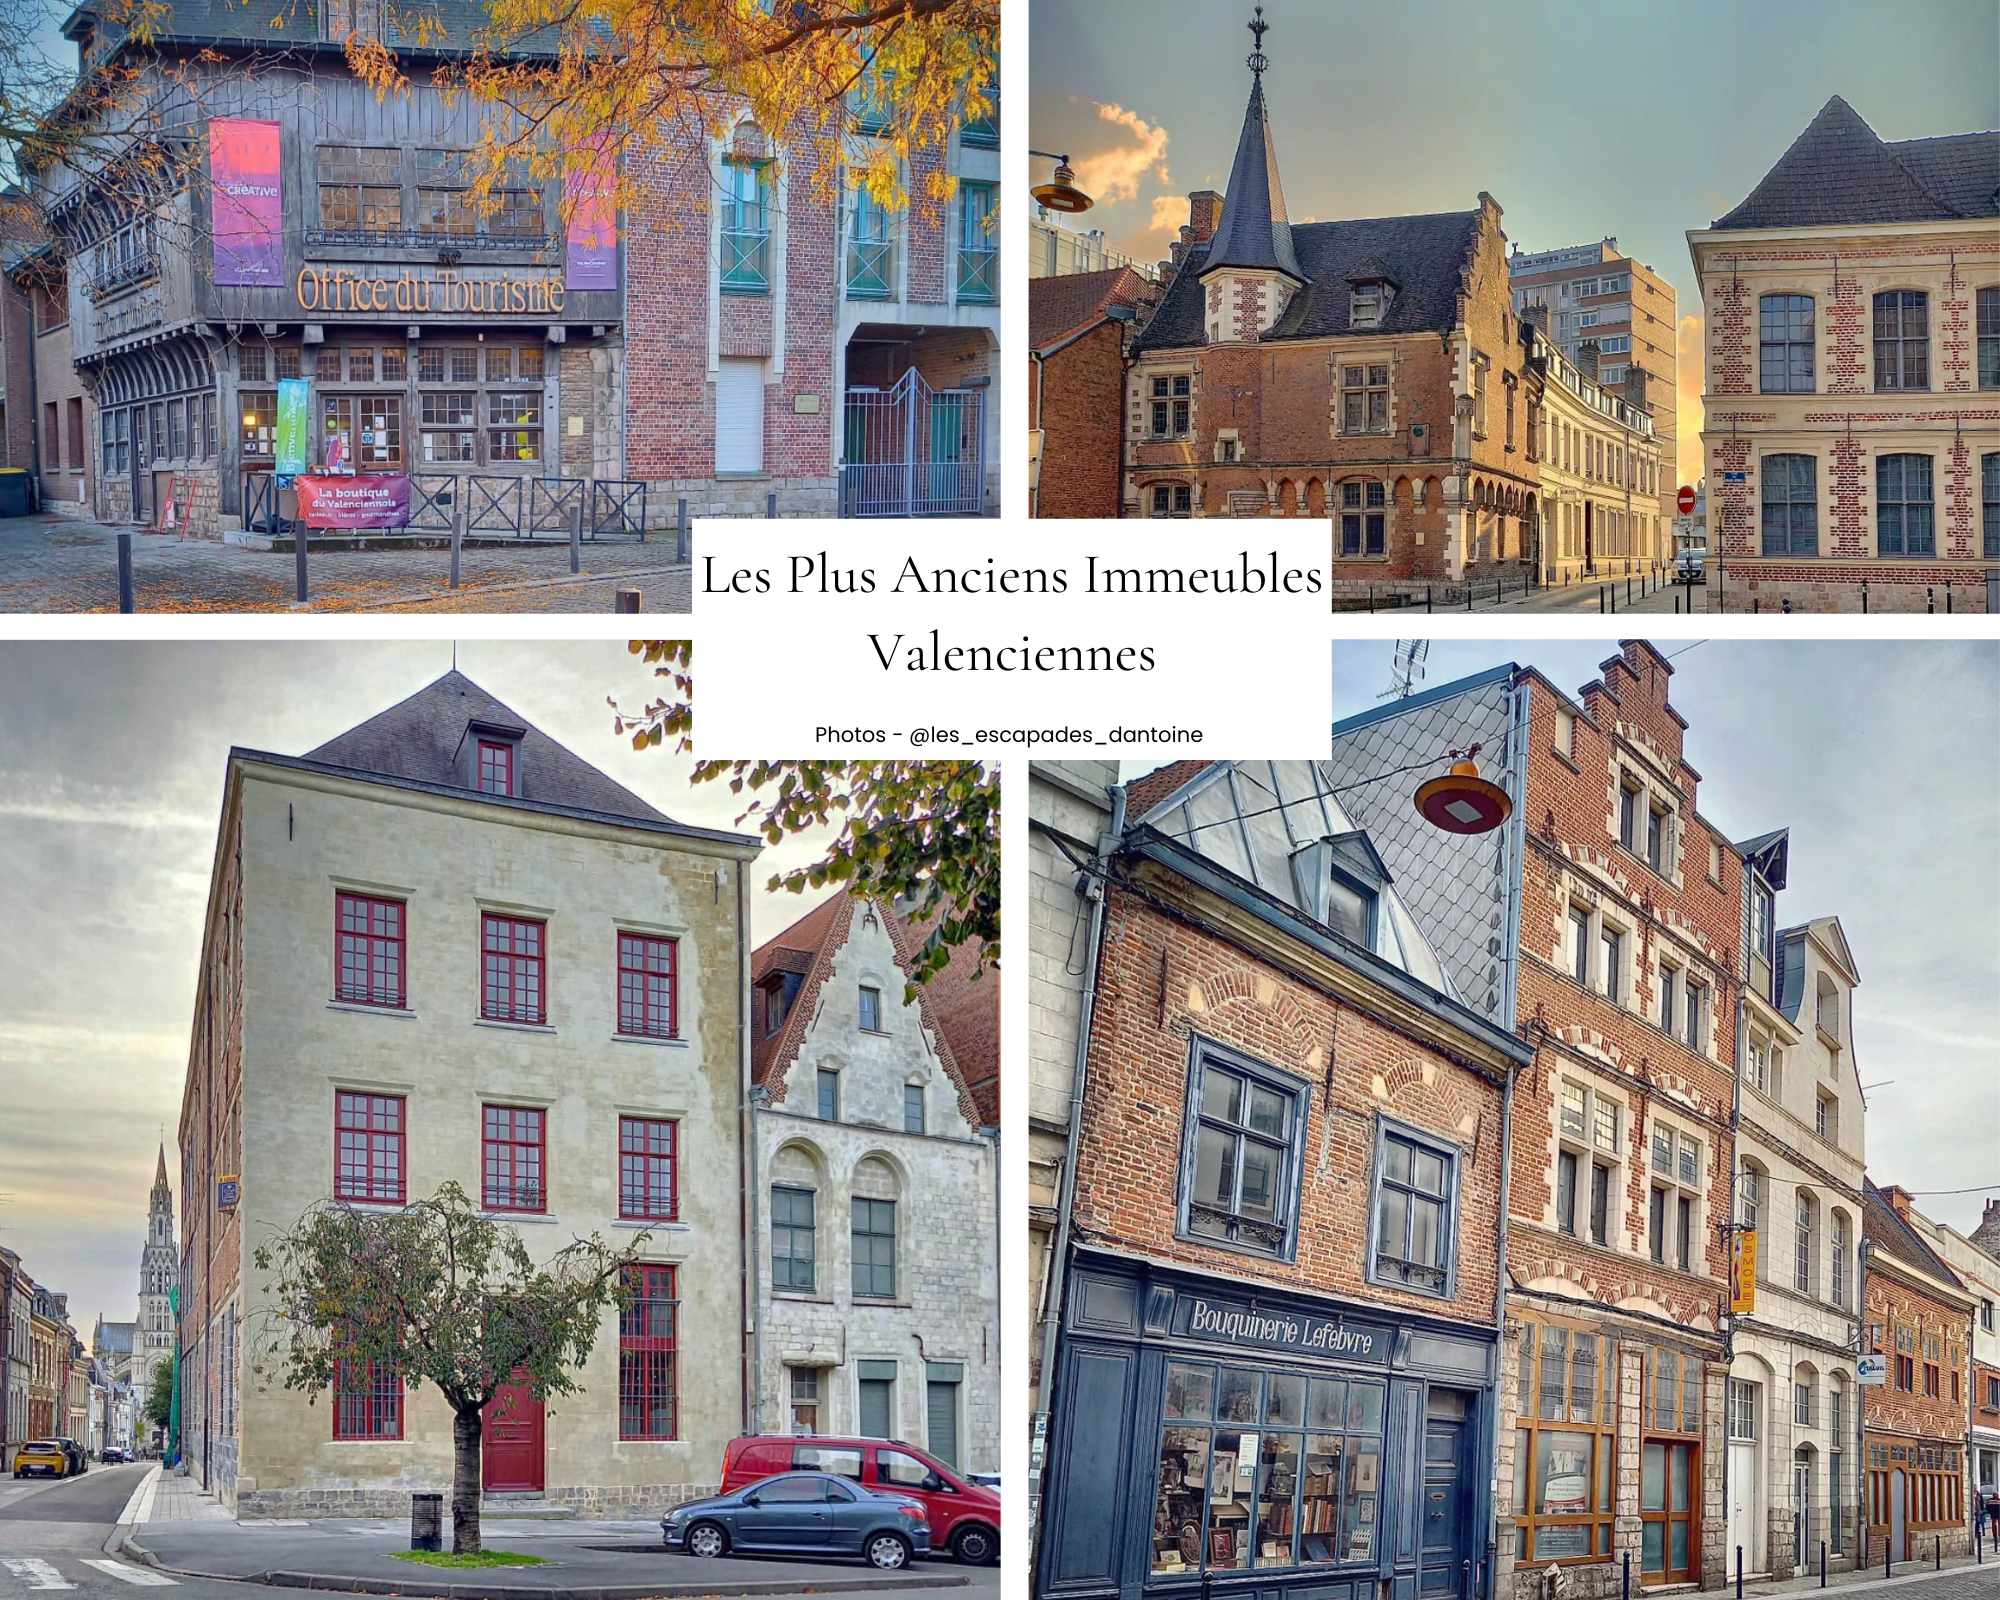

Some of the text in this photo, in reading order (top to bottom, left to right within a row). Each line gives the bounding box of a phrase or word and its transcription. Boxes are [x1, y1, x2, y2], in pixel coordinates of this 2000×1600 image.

[297, 267, 566, 313] Office du Tourisme
[312, 499, 396, 509] du Valenciennois
[318, 488, 389, 499] La boutique
[308, 511, 332, 519] cadeaux
[1743, 1233, 1754, 1301] OSMOSE
[1191, 1300, 1373, 1355] Bouquinerie Lefebvre
